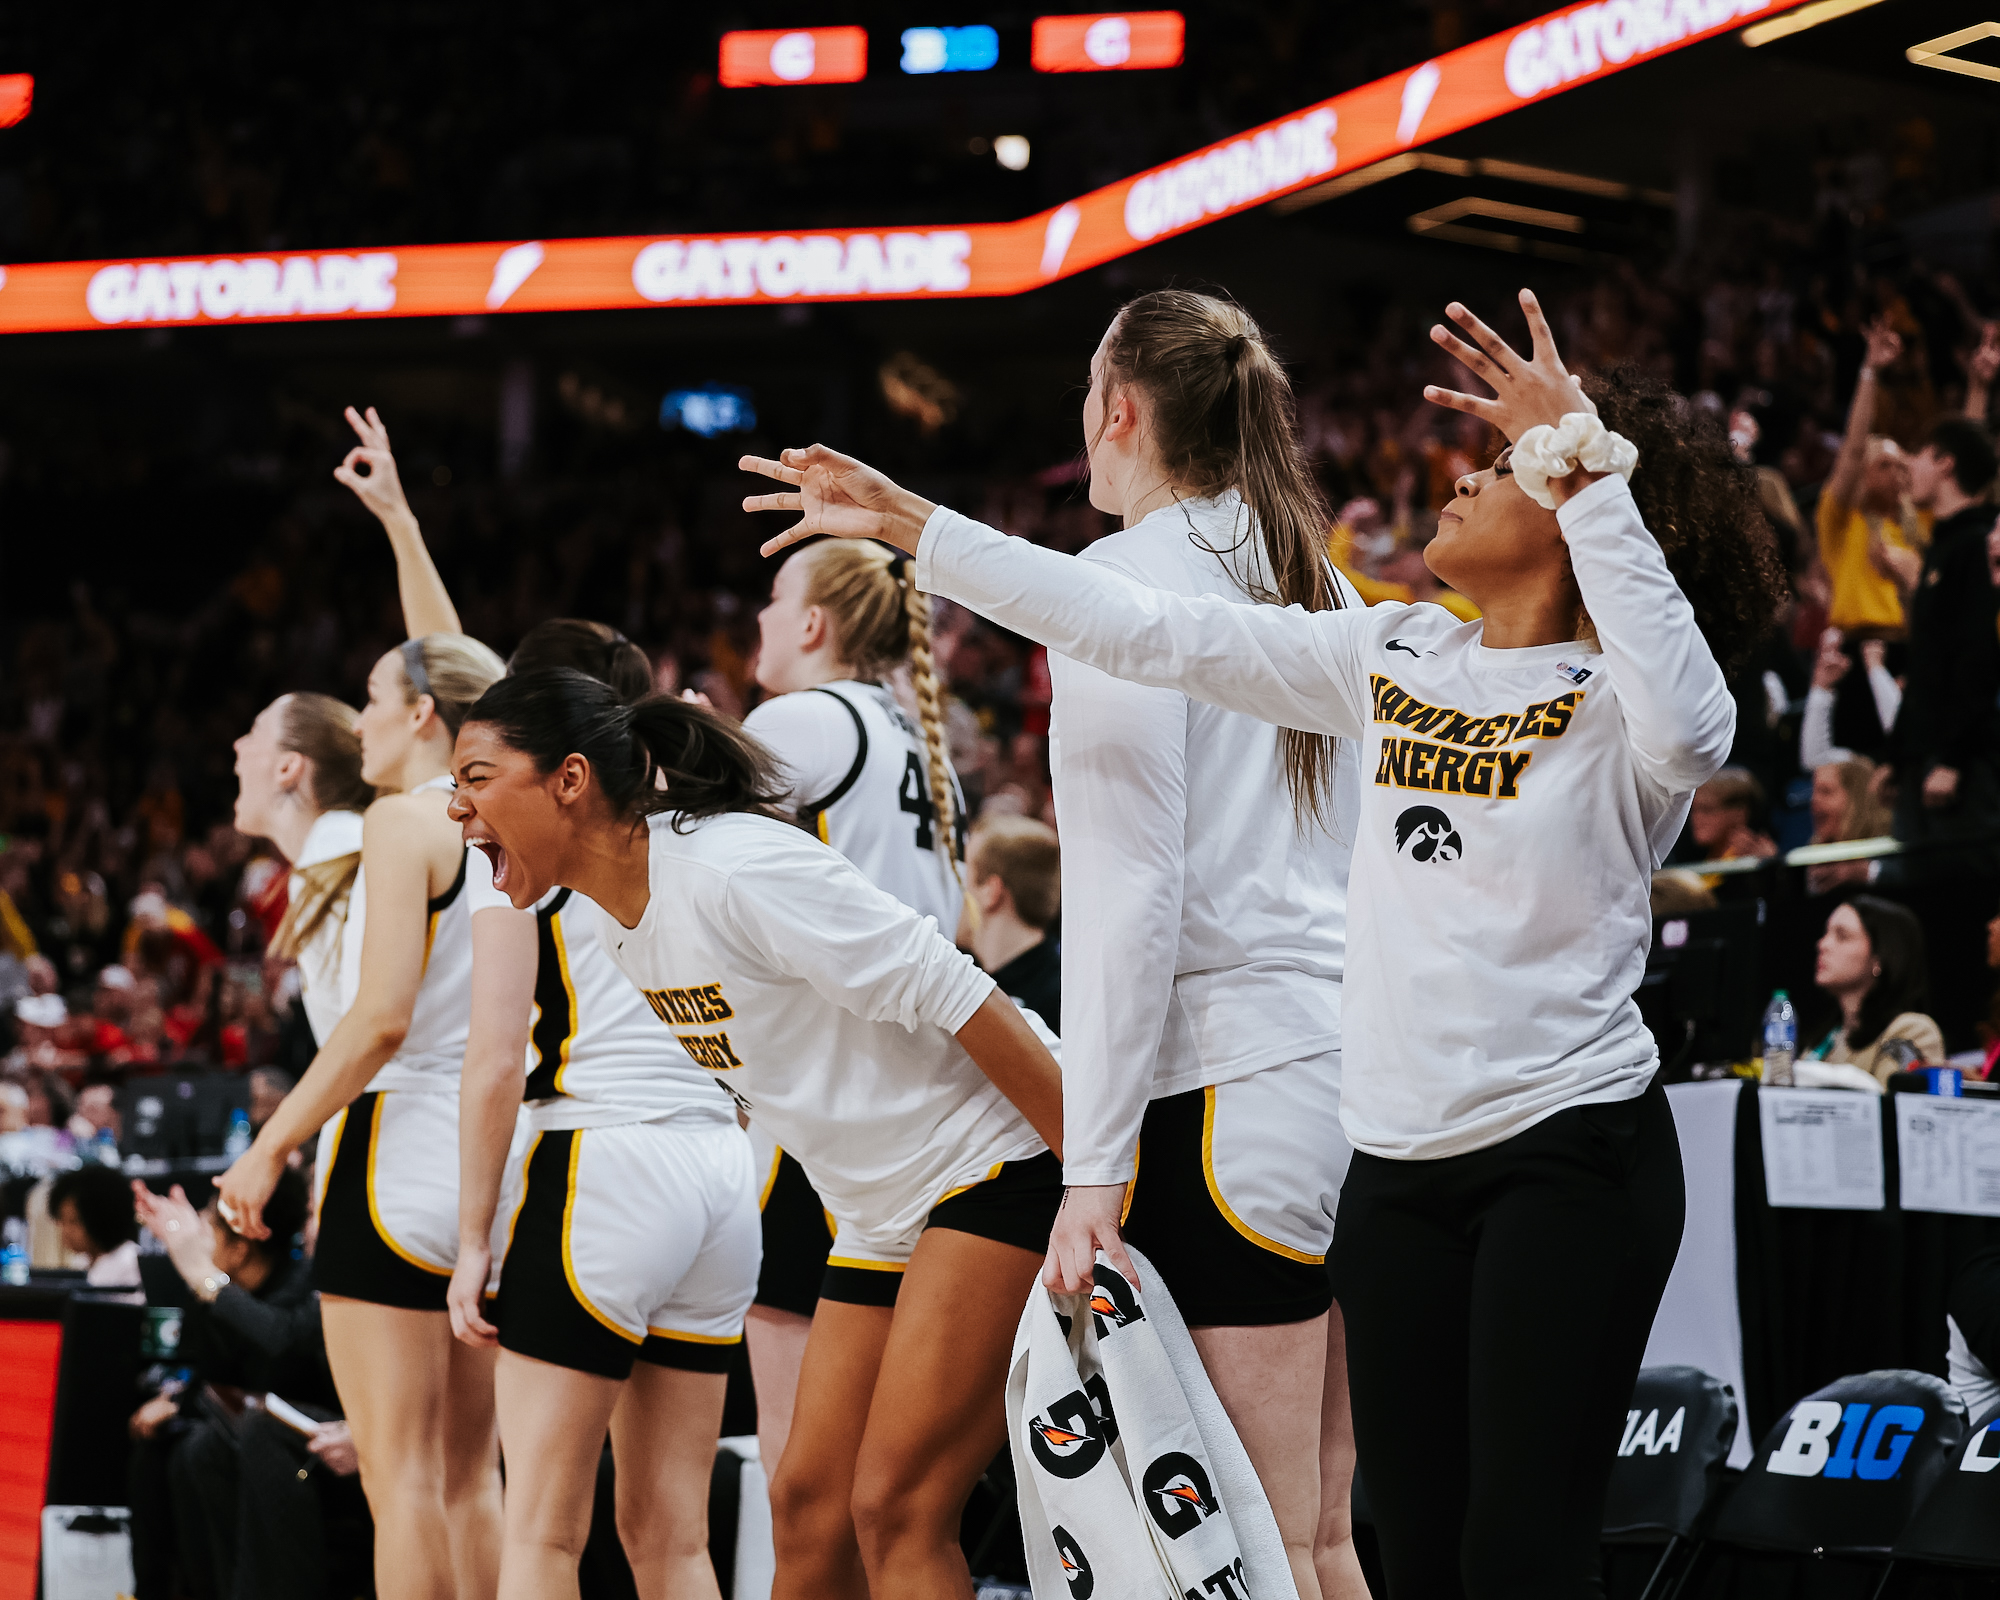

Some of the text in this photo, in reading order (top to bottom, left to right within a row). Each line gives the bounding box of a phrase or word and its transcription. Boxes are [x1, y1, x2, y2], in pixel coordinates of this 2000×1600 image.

[86, 252, 398, 325] GATORADE
[632, 230, 972, 302] GATORADE
[1029, 1389, 1106, 1479] G
[1142, 1451, 1220, 1540] G
